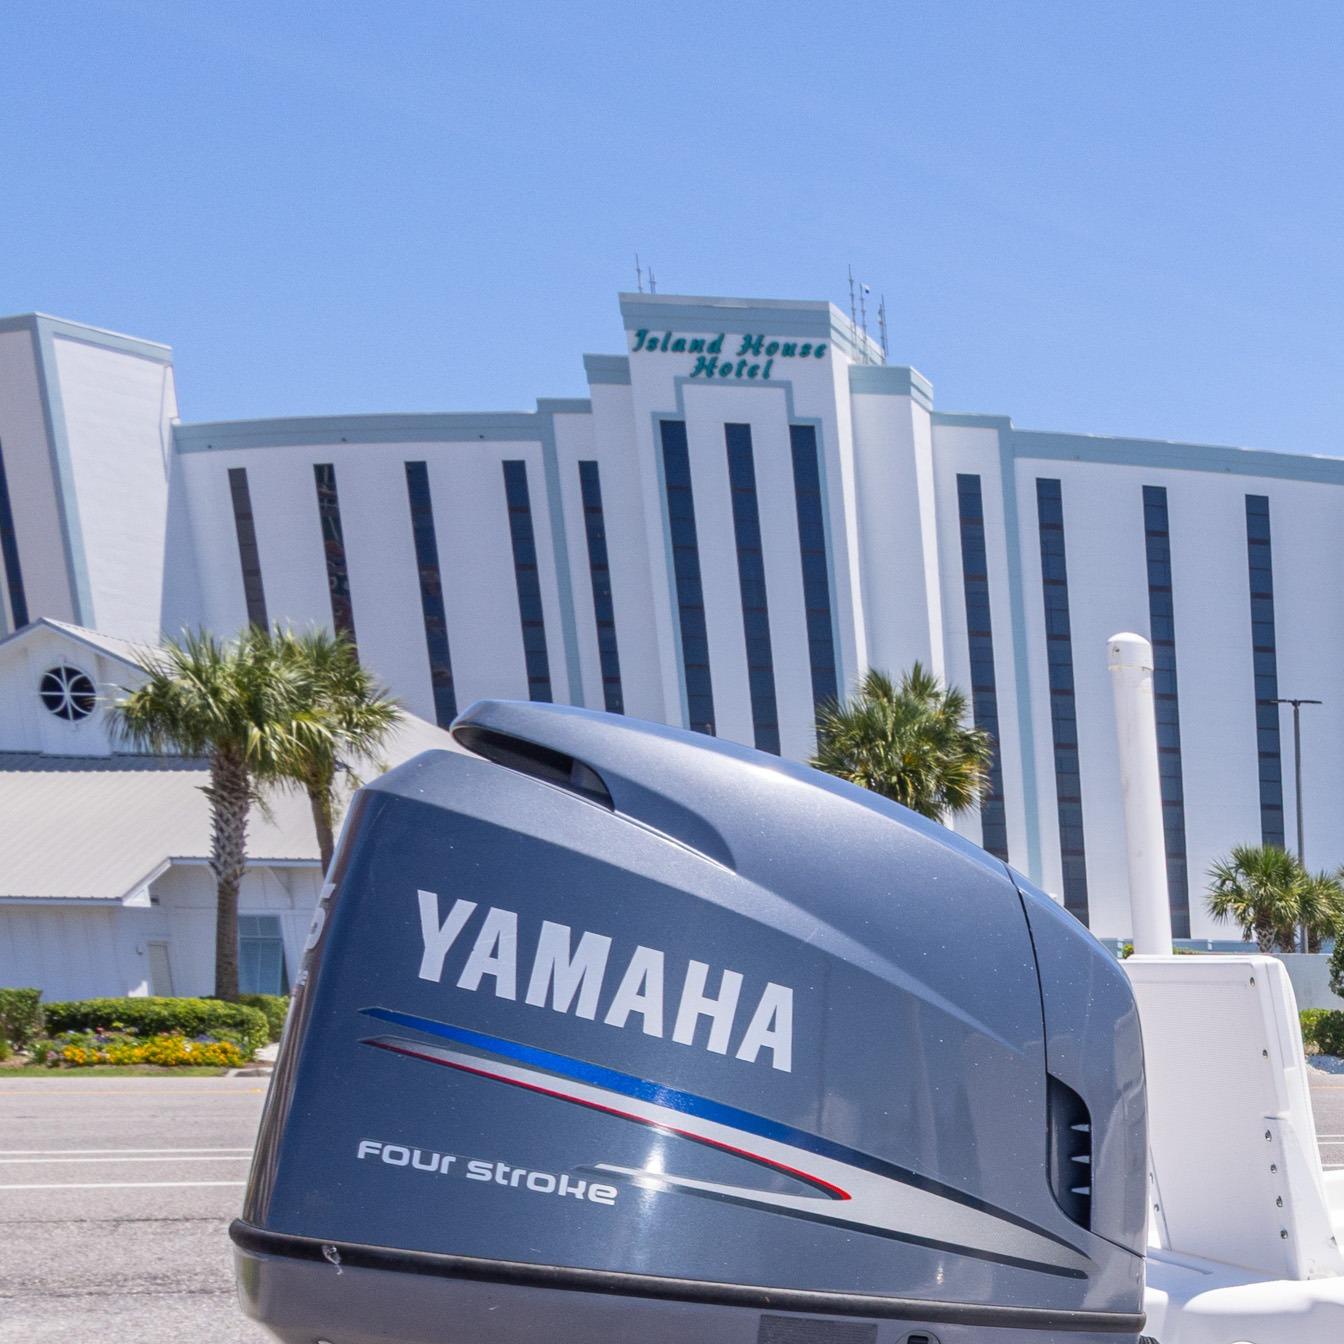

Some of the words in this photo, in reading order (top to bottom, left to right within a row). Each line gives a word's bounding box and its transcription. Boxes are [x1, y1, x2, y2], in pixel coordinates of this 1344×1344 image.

[632, 329, 725, 354] Island
[735, 334, 828, 359] House
[690, 355, 774, 379] Hotel
[416, 889, 793, 1073] YAMAHA
